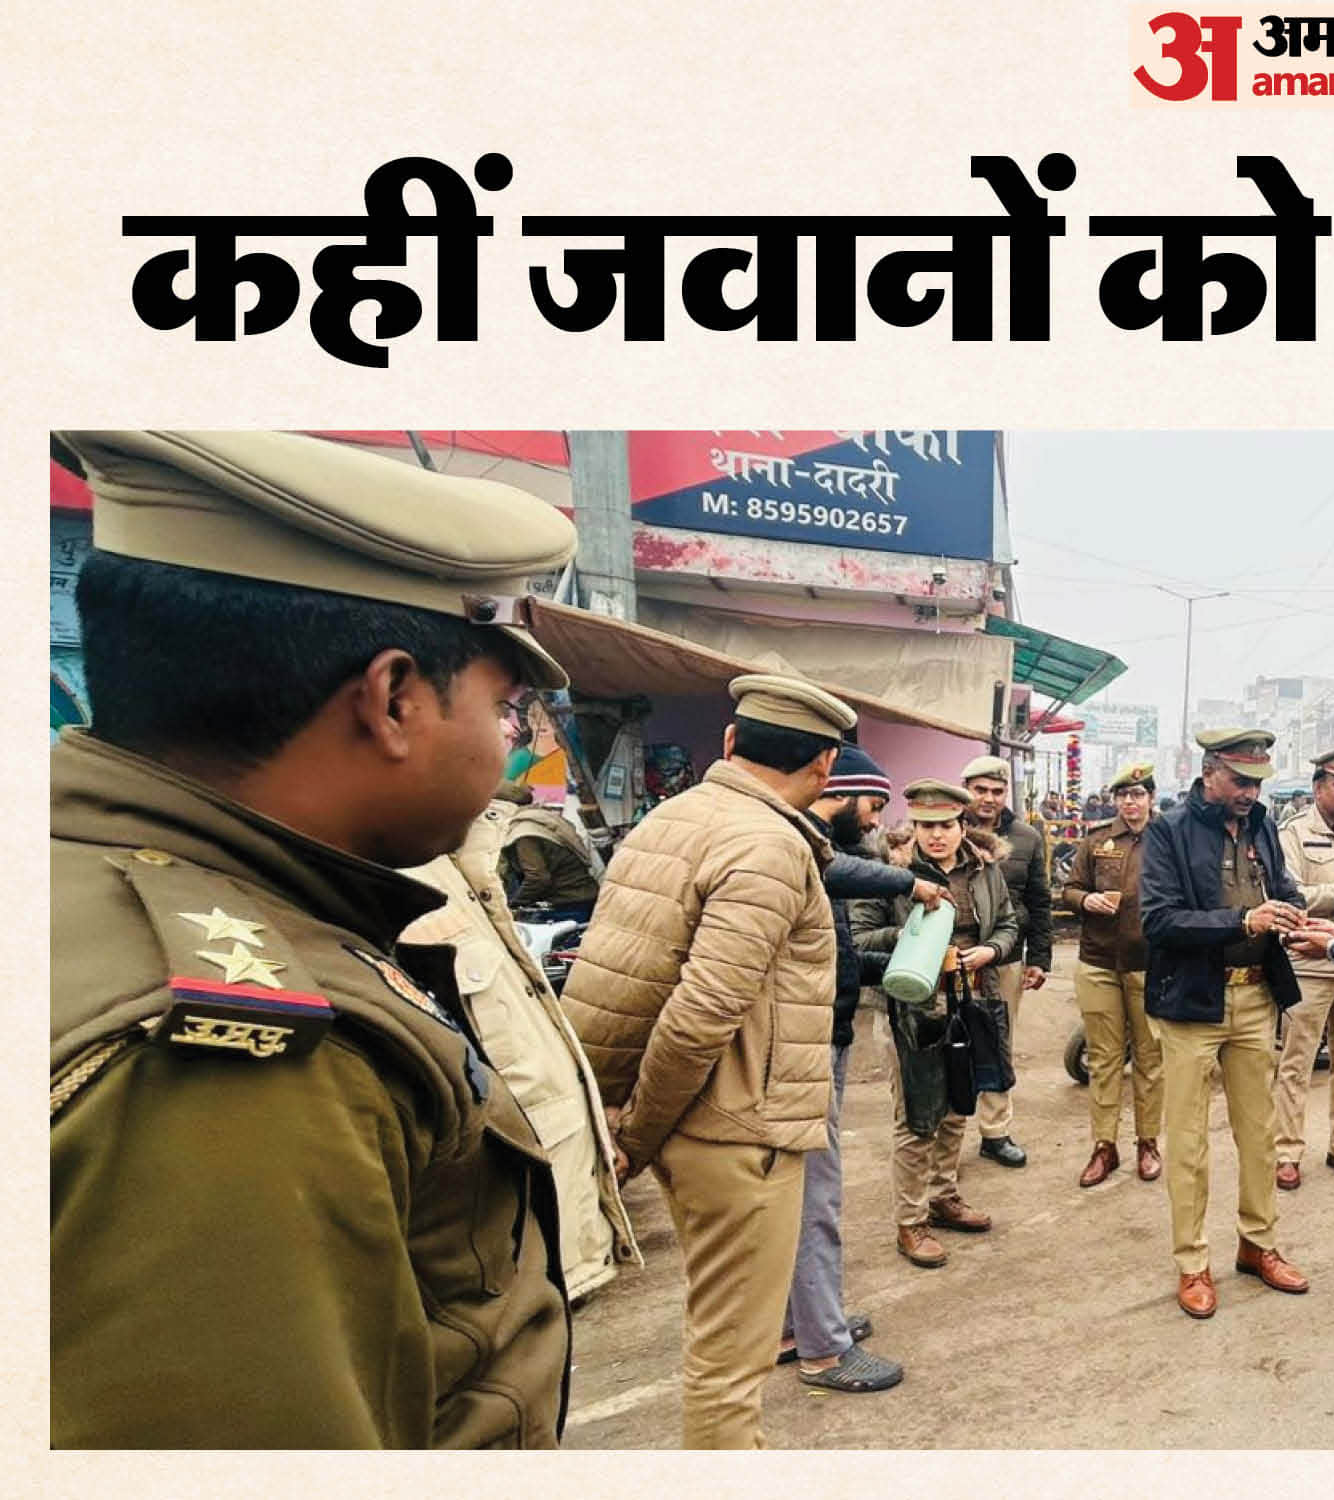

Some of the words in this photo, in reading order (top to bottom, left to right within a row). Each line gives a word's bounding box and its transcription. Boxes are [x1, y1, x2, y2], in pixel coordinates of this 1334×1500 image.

[710, 448, 900, 505] थाना-दादरी
[702, 492, 737, 516] M:
[747, 497, 909, 537] 8595902657
